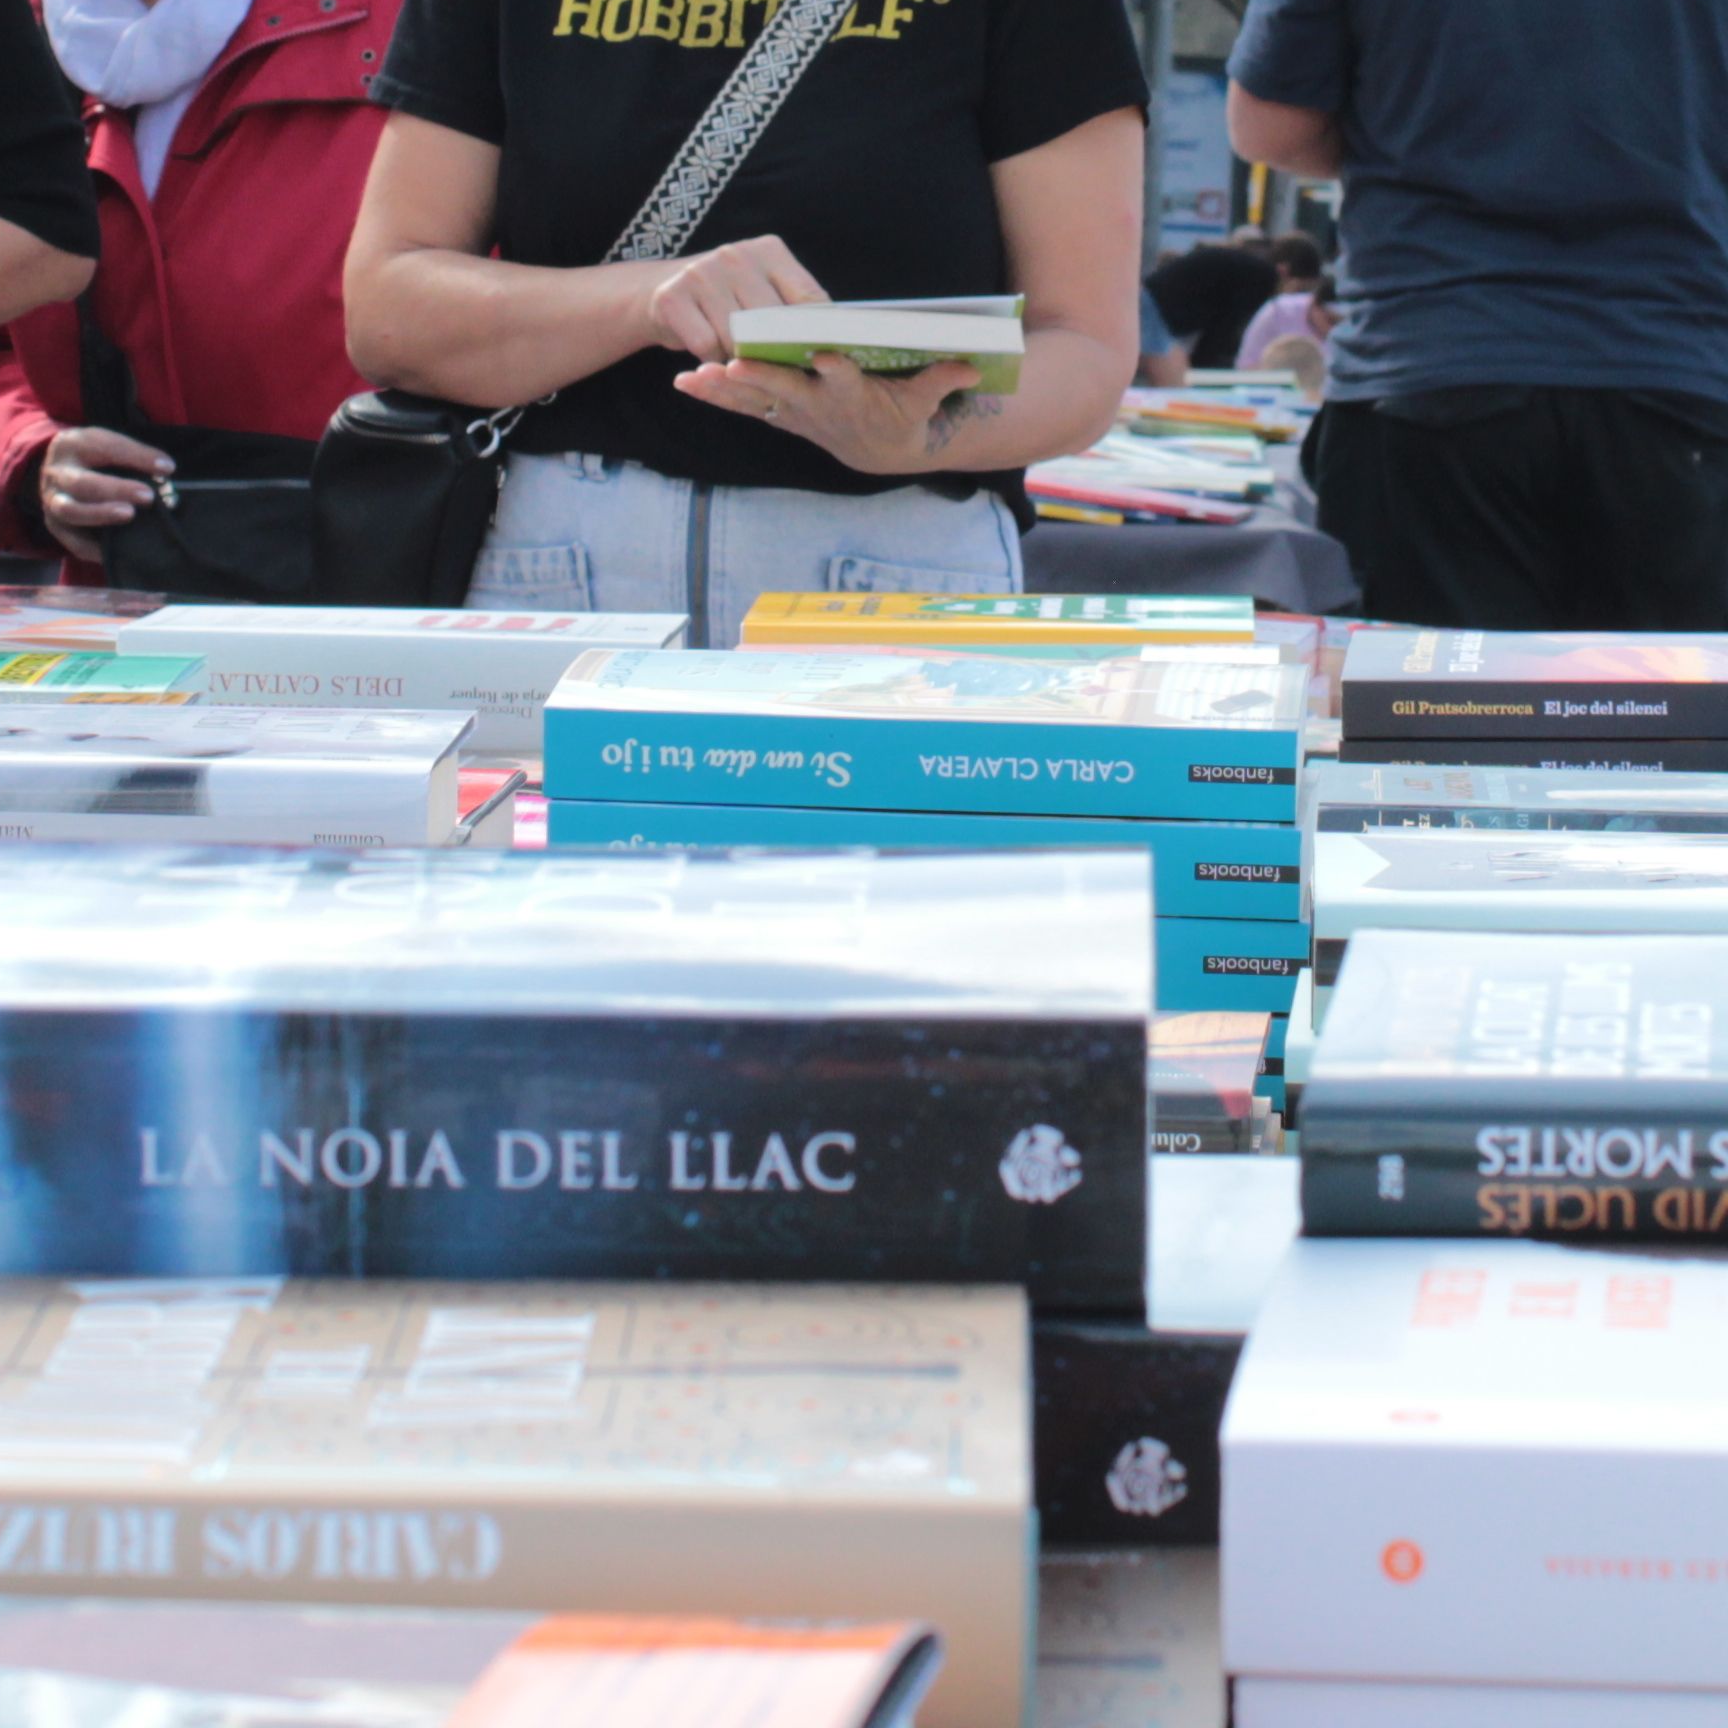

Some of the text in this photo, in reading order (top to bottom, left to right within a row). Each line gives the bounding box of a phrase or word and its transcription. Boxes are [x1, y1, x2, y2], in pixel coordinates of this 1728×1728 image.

[330, 673, 404, 699] DELS
[1391, 699, 1669, 717] Gil Pratsobrerroca El joc del silenci
[600, 739, 639, 775] jo
[658, 744, 696, 774] tu
[762, 750, 805, 775] un
[810, 747, 853, 788] Si
[919, 752, 1040, 784] CLAVERA
[1045, 755, 1136, 785] CARLA
[1193, 764, 1275, 786] fanbooks
[1197, 862, 1281, 885] fanbooks
[1206, 956, 1289, 976] fanbooks
[139, 1125, 860, 1195] LA NOIA DEL LLAC
[1474, 1125, 1694, 1184] MORTES
[1474, 1177, 1638, 1232] UCLÉS
[207, 1506, 501, 1582] CARLOS
